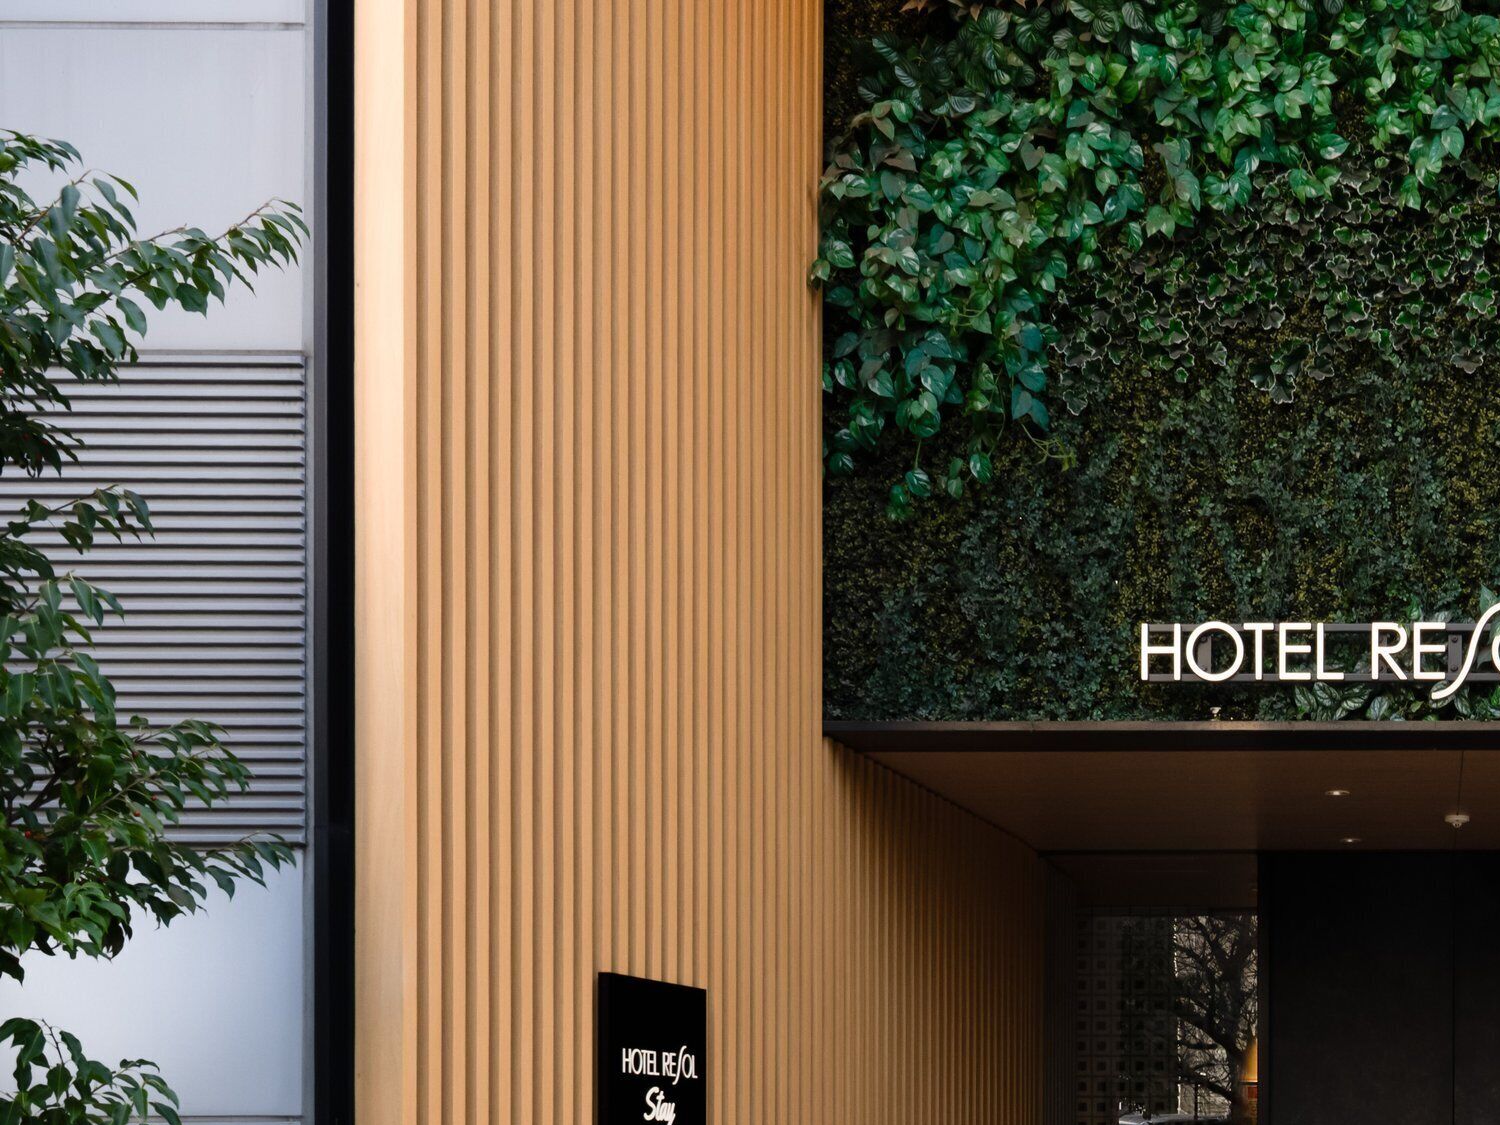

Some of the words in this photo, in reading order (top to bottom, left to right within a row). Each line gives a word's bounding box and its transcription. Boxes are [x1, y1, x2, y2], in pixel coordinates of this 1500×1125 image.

[1140, 621, 1345, 682] HOTEL
[622, 1047, 660, 1076] HOTEL
[661, 1045, 699, 1086] RESOL
